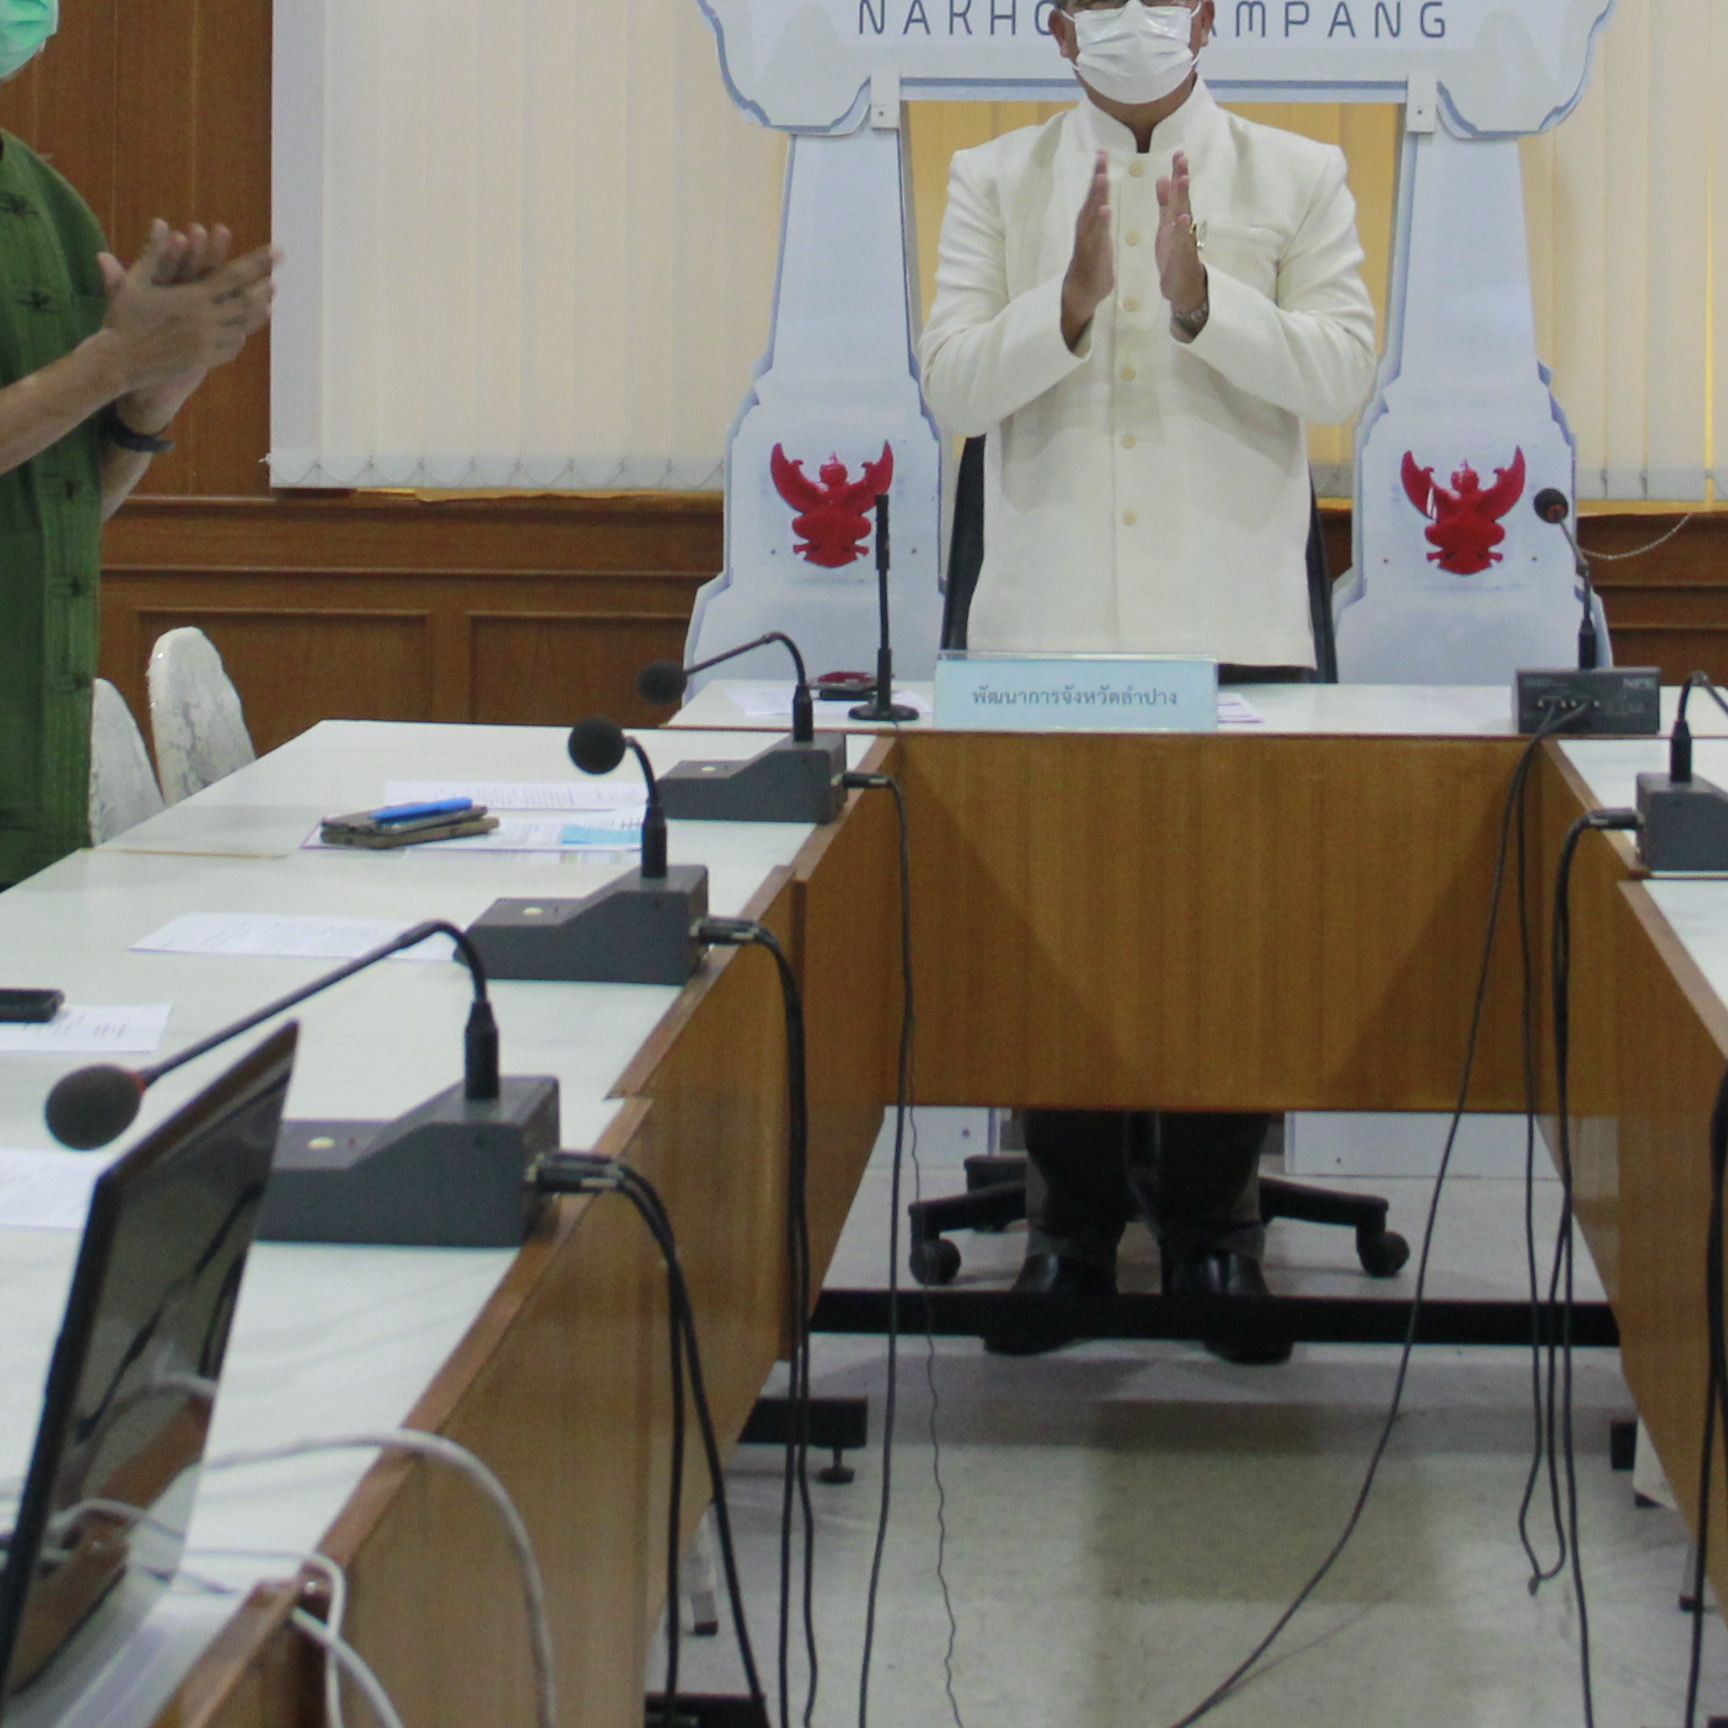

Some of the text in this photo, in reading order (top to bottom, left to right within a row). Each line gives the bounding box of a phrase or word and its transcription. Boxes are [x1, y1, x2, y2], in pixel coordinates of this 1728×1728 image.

[1212, 0, 1447, 39] MPANG
[972, 684, 1178, 706] พัฒนาการจังหวัดลำปาง
